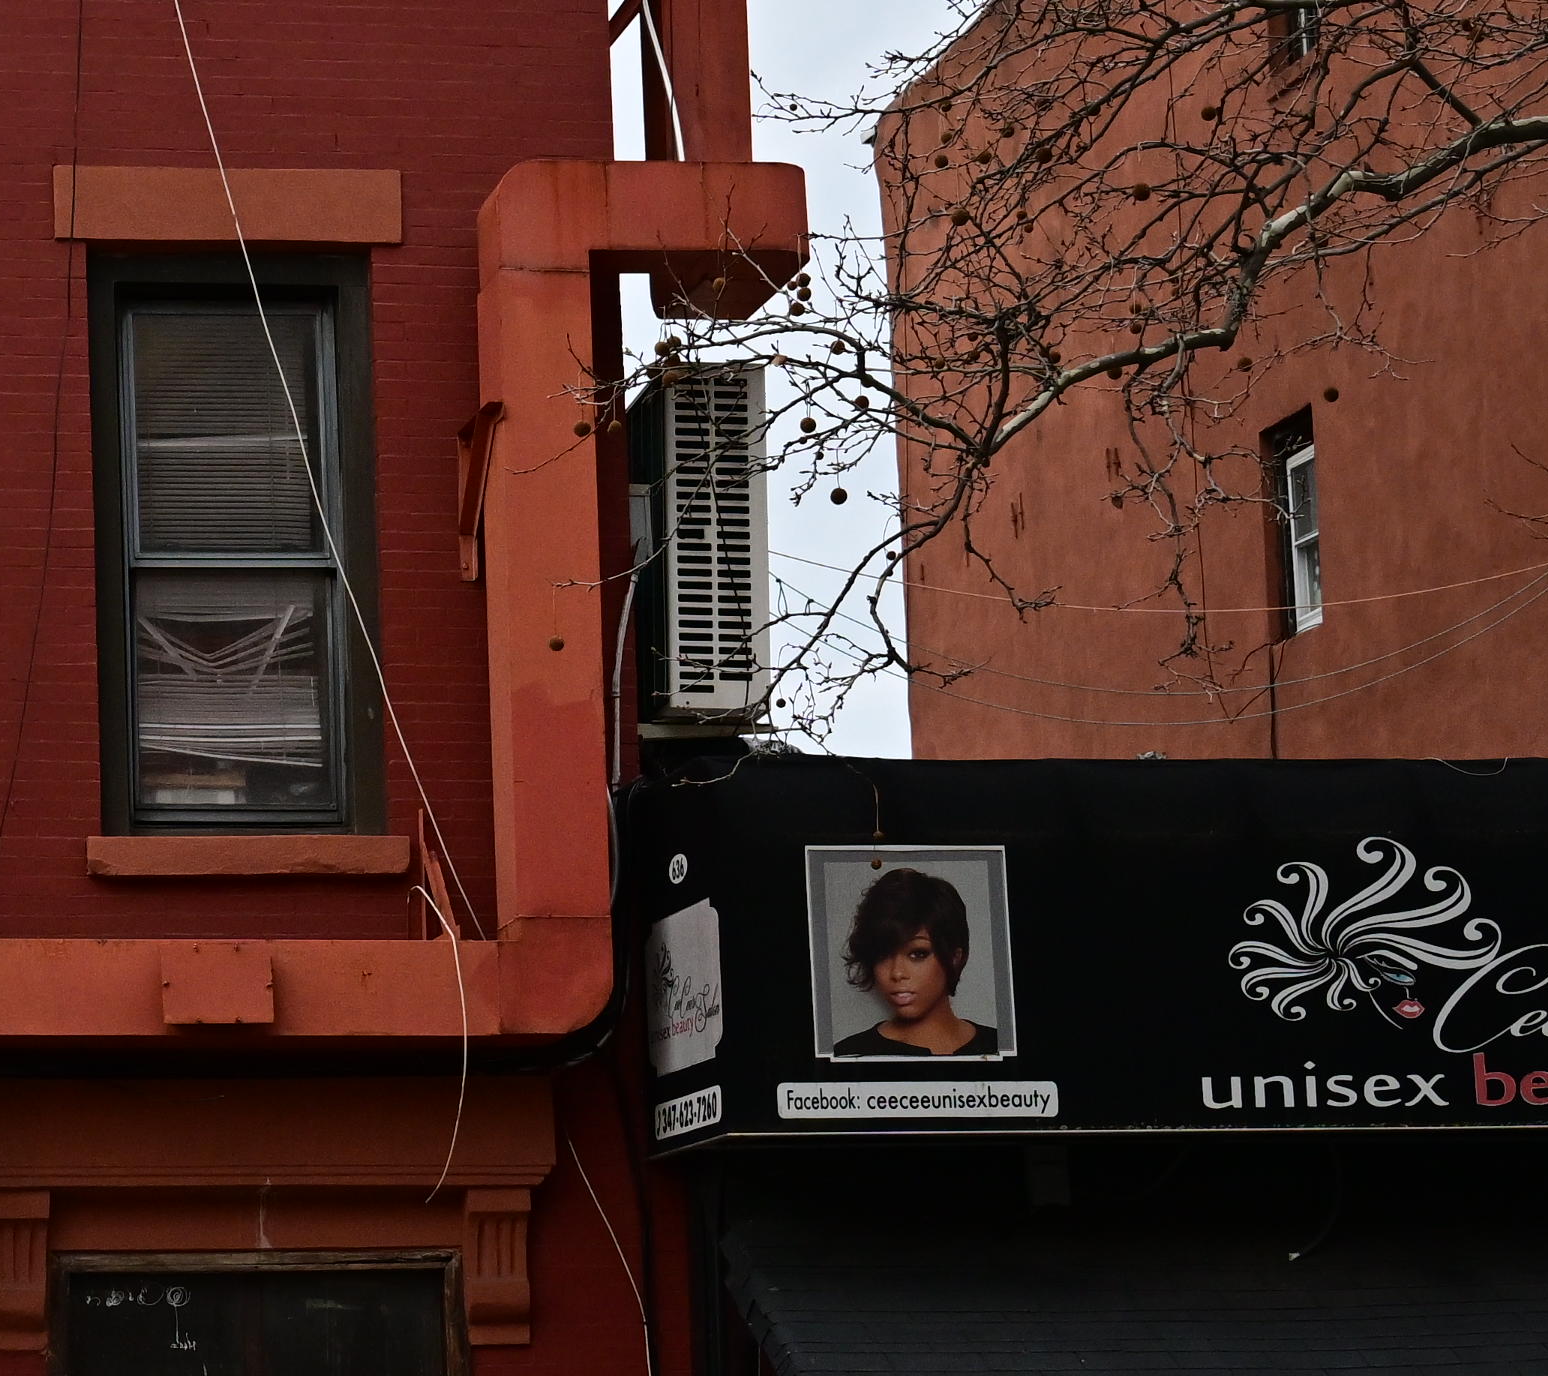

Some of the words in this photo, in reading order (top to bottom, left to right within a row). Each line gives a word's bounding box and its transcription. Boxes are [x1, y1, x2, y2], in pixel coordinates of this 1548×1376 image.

[786, 1087, 861, 1111] Facebook:
[866, 1085, 1051, 1114] ceeceeunisexbeauty
[1199, 1060, 1450, 1109] unisex
[662, 1091, 717, 1134] 347-623-7260
